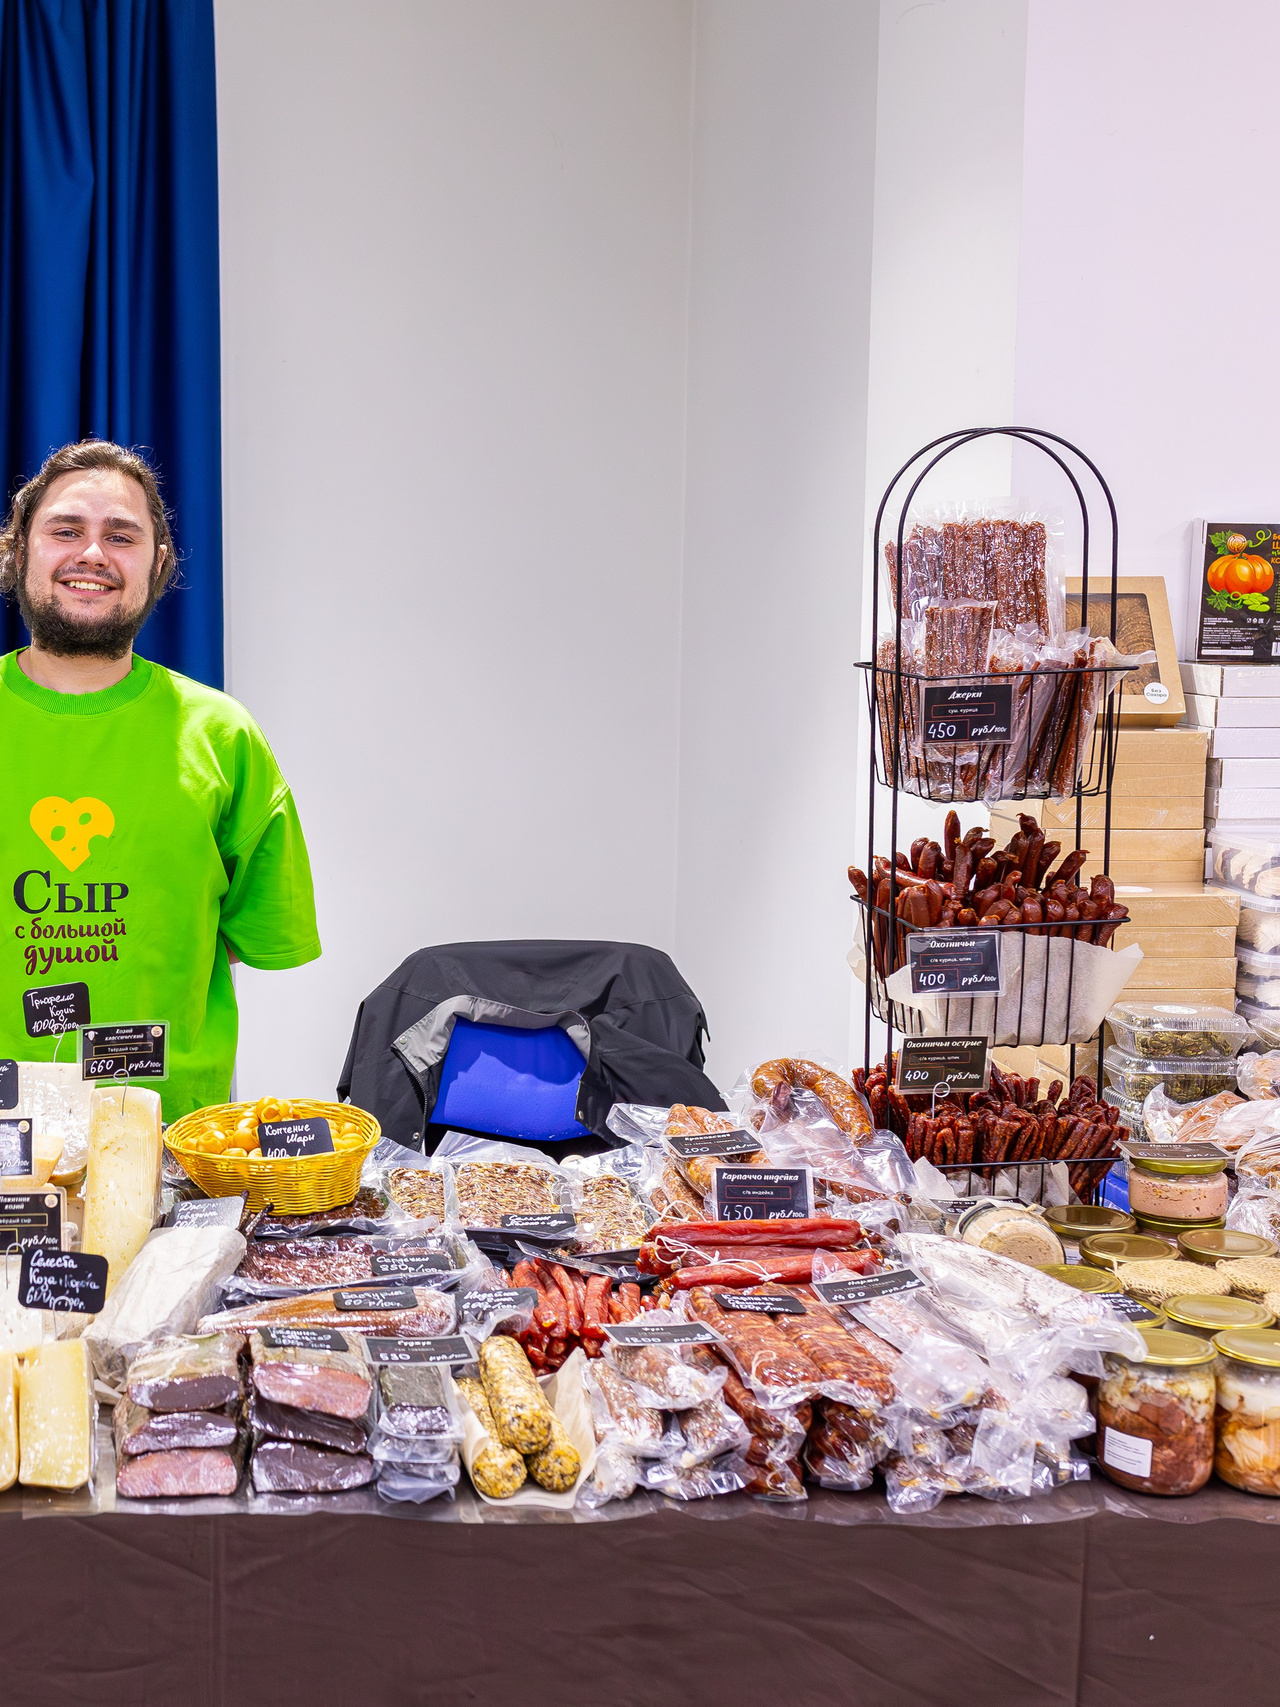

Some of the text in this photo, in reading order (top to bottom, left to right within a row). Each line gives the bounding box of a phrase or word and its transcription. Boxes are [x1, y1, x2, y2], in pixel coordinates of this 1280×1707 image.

[947, 690, 983, 701] Джерки
[927, 722, 957, 739] 450
[15, 916, 127, 940] с большой
[929, 940, 976, 949] Охотничьи
[23, 938, 119, 976] душой
[919, 972, 946, 986] 400
[48, 1004, 76, 1022] Козий
[906, 1040, 983, 1049] Охотничьи острые
[90, 1059, 114, 1074] 660
[904, 1070, 930, 1082] 400
[684, 1146, 710, 1154] 200
[721, 1172, 800, 1184] Карпаччо индейка
[722, 1204, 754, 1220] 450
[30, 1248, 78, 1269] Селеста
[29, 1266, 58, 1292] Коза
